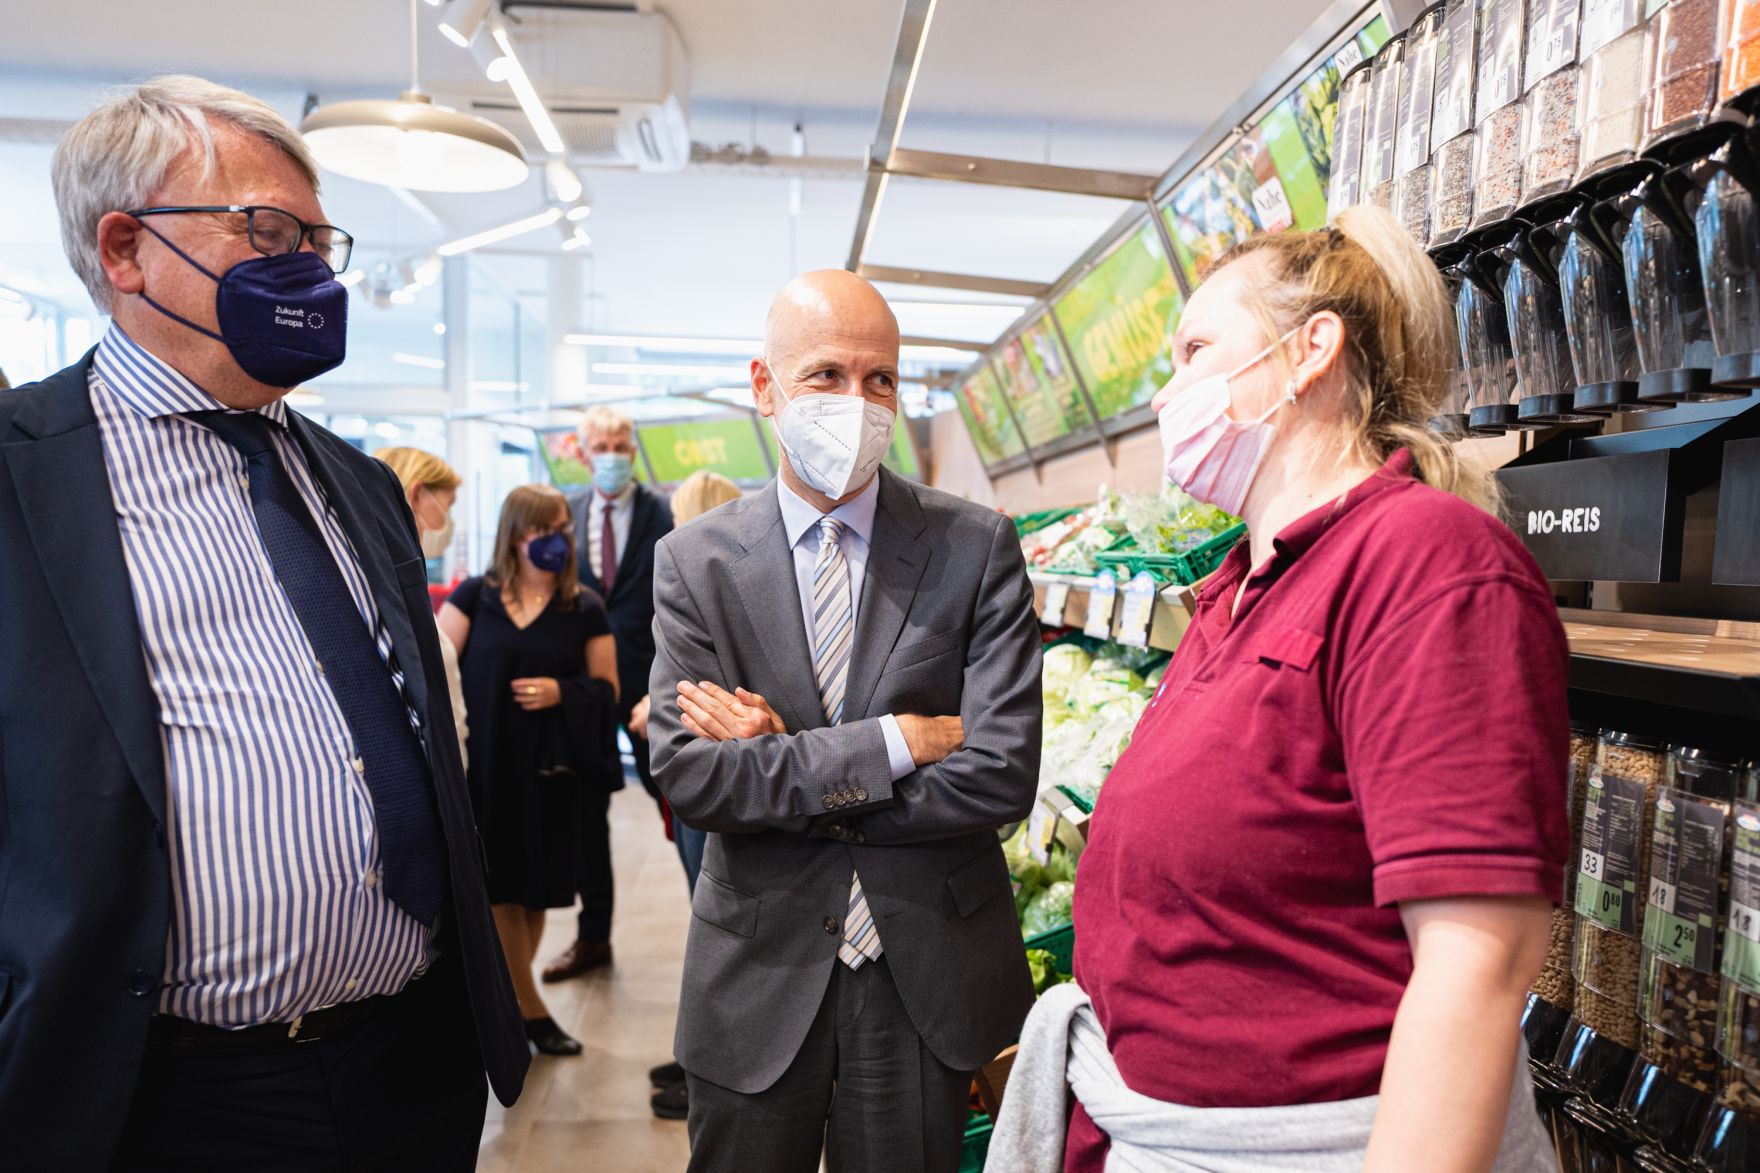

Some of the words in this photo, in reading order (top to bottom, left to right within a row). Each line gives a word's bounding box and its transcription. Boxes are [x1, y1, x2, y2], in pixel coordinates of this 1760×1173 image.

[275, 305, 304, 317] Zukunft
[275, 315, 304, 328] Europa
[1527, 506, 1601, 535] BIO-REIS
[1584, 853, 1598, 874] 33
[1652, 885, 1667, 905] 18
[1733, 908, 1752, 931] 18
